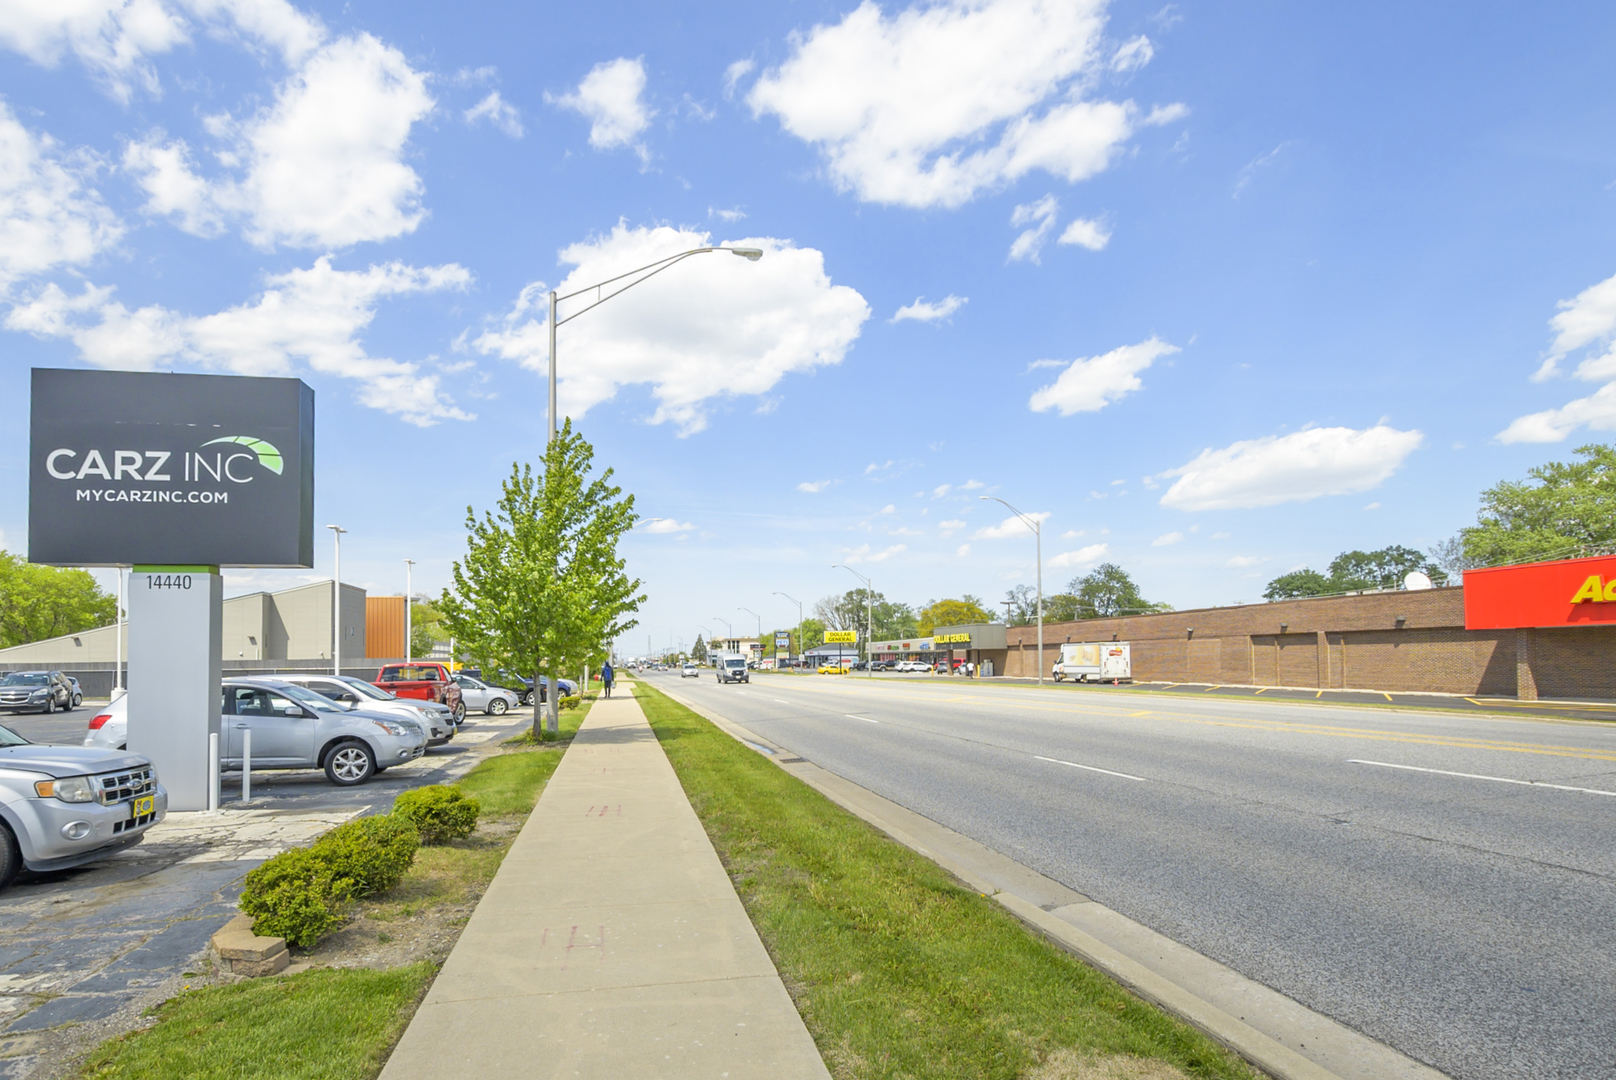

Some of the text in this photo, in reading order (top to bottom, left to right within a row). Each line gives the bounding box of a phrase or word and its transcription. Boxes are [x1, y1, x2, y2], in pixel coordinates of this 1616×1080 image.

[46, 448, 254, 483] CARZ INC
[76, 489, 228, 504] MYCARZINC.COM
[146, 574, 192, 590] 14440
[934, 633, 970, 643] DOLLAR GENERAL
